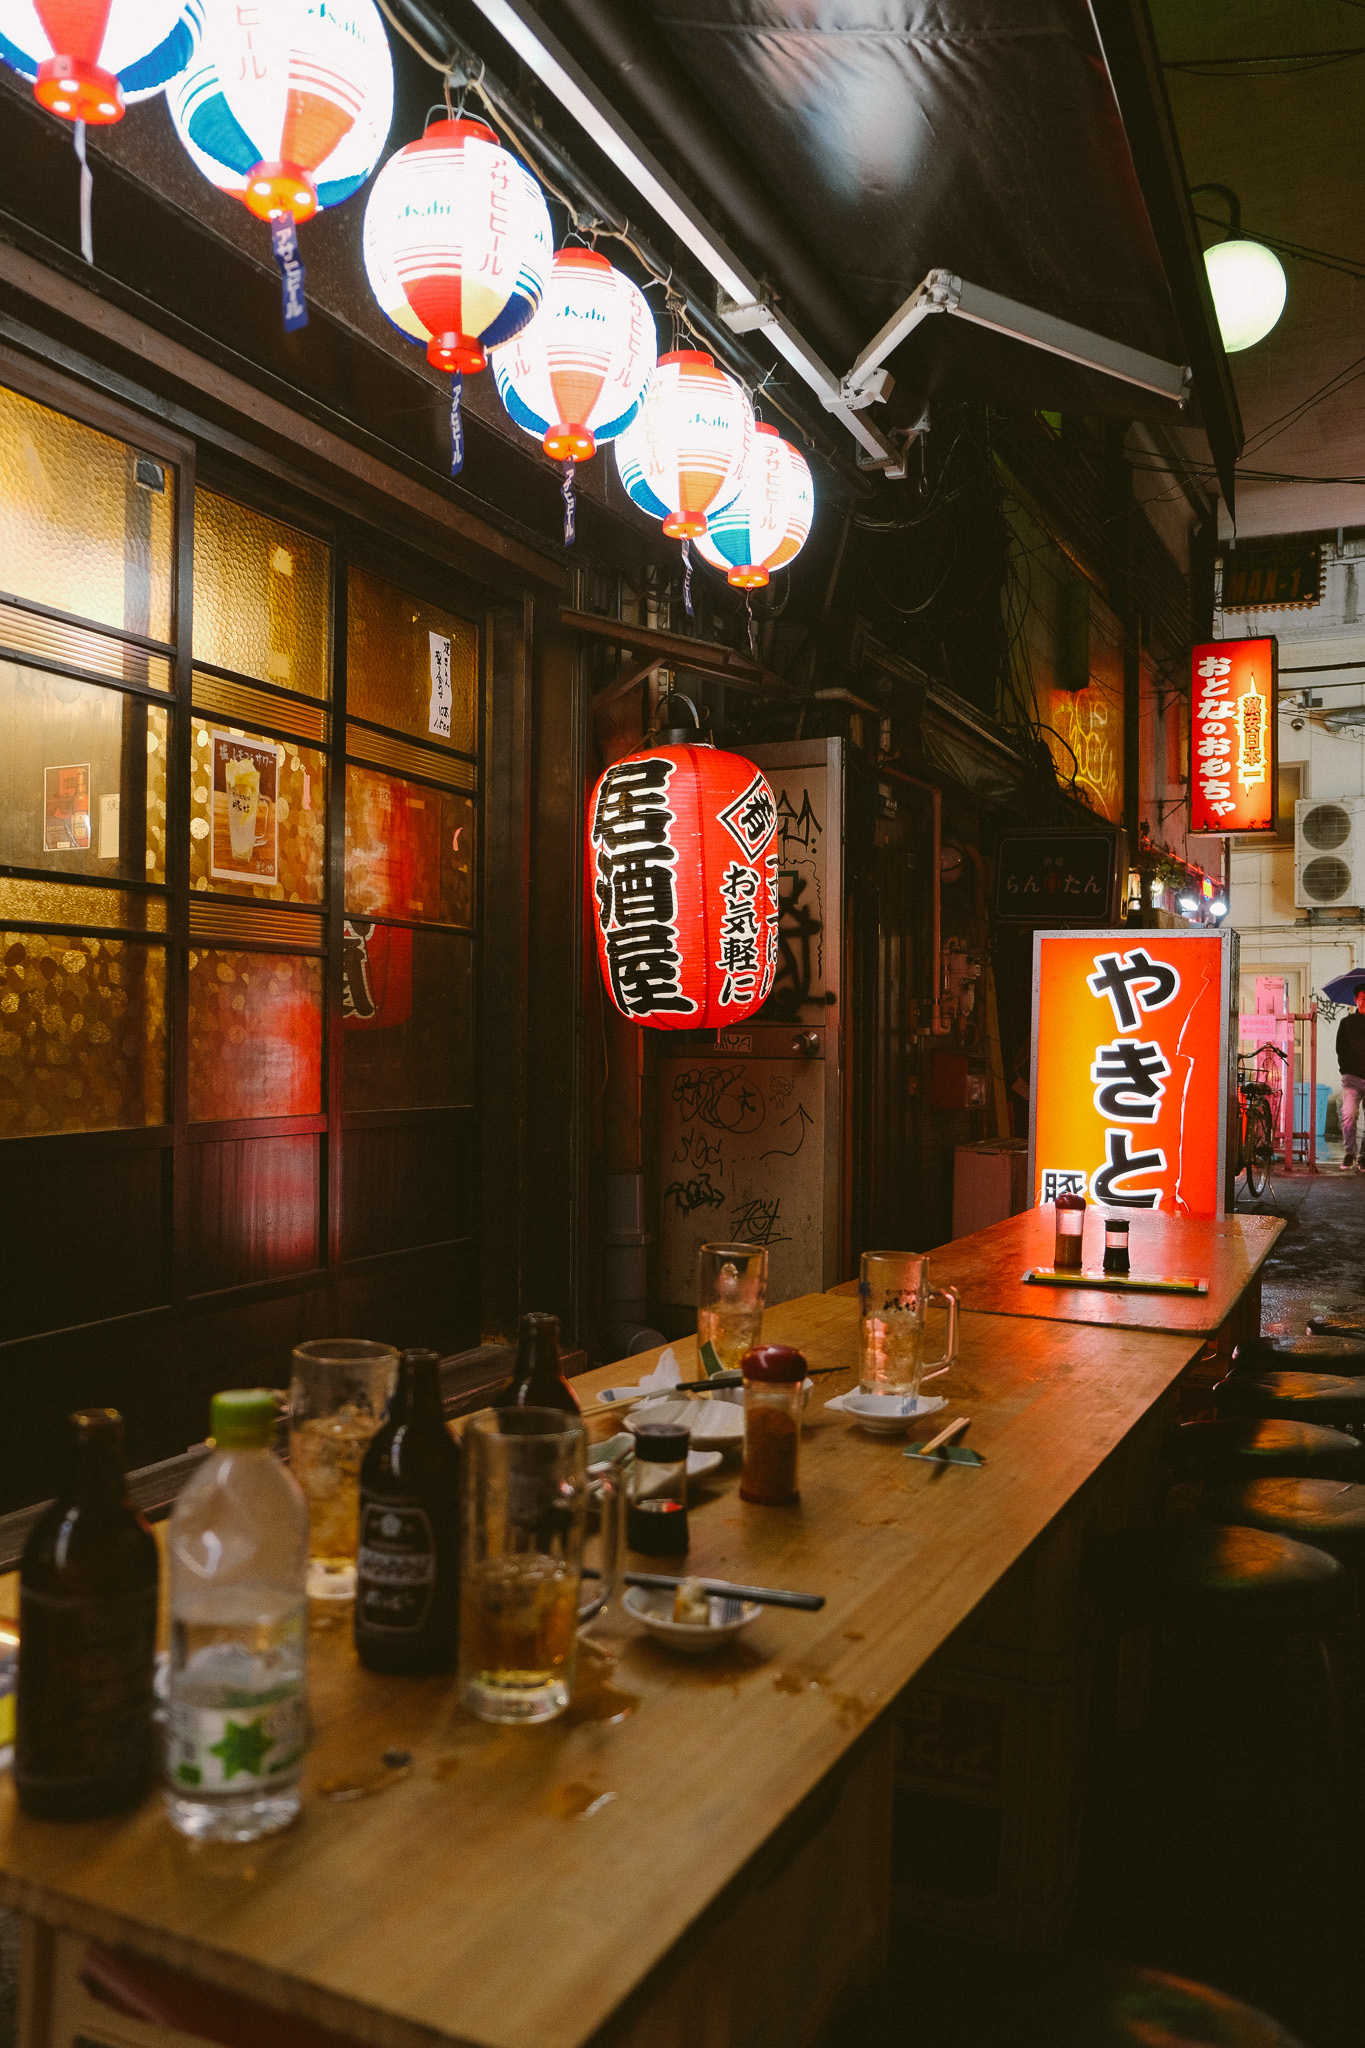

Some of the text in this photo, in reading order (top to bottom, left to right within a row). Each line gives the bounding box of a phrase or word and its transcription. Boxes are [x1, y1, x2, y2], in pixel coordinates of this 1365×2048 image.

[555, 305, 606, 323] Asahi
[688, 411, 730, 430] Asahi
[1225, 567, 1302, 603] MAX-1
[1197, 656, 1237, 817] おとなのおもちゃ
[1243, 696, 1262, 777] 激安日本一
[592, 757, 698, 1019] 居酒屋
[715, 861, 761, 1007] お気軽に
[1086, 947, 1181, 1209] やきと
